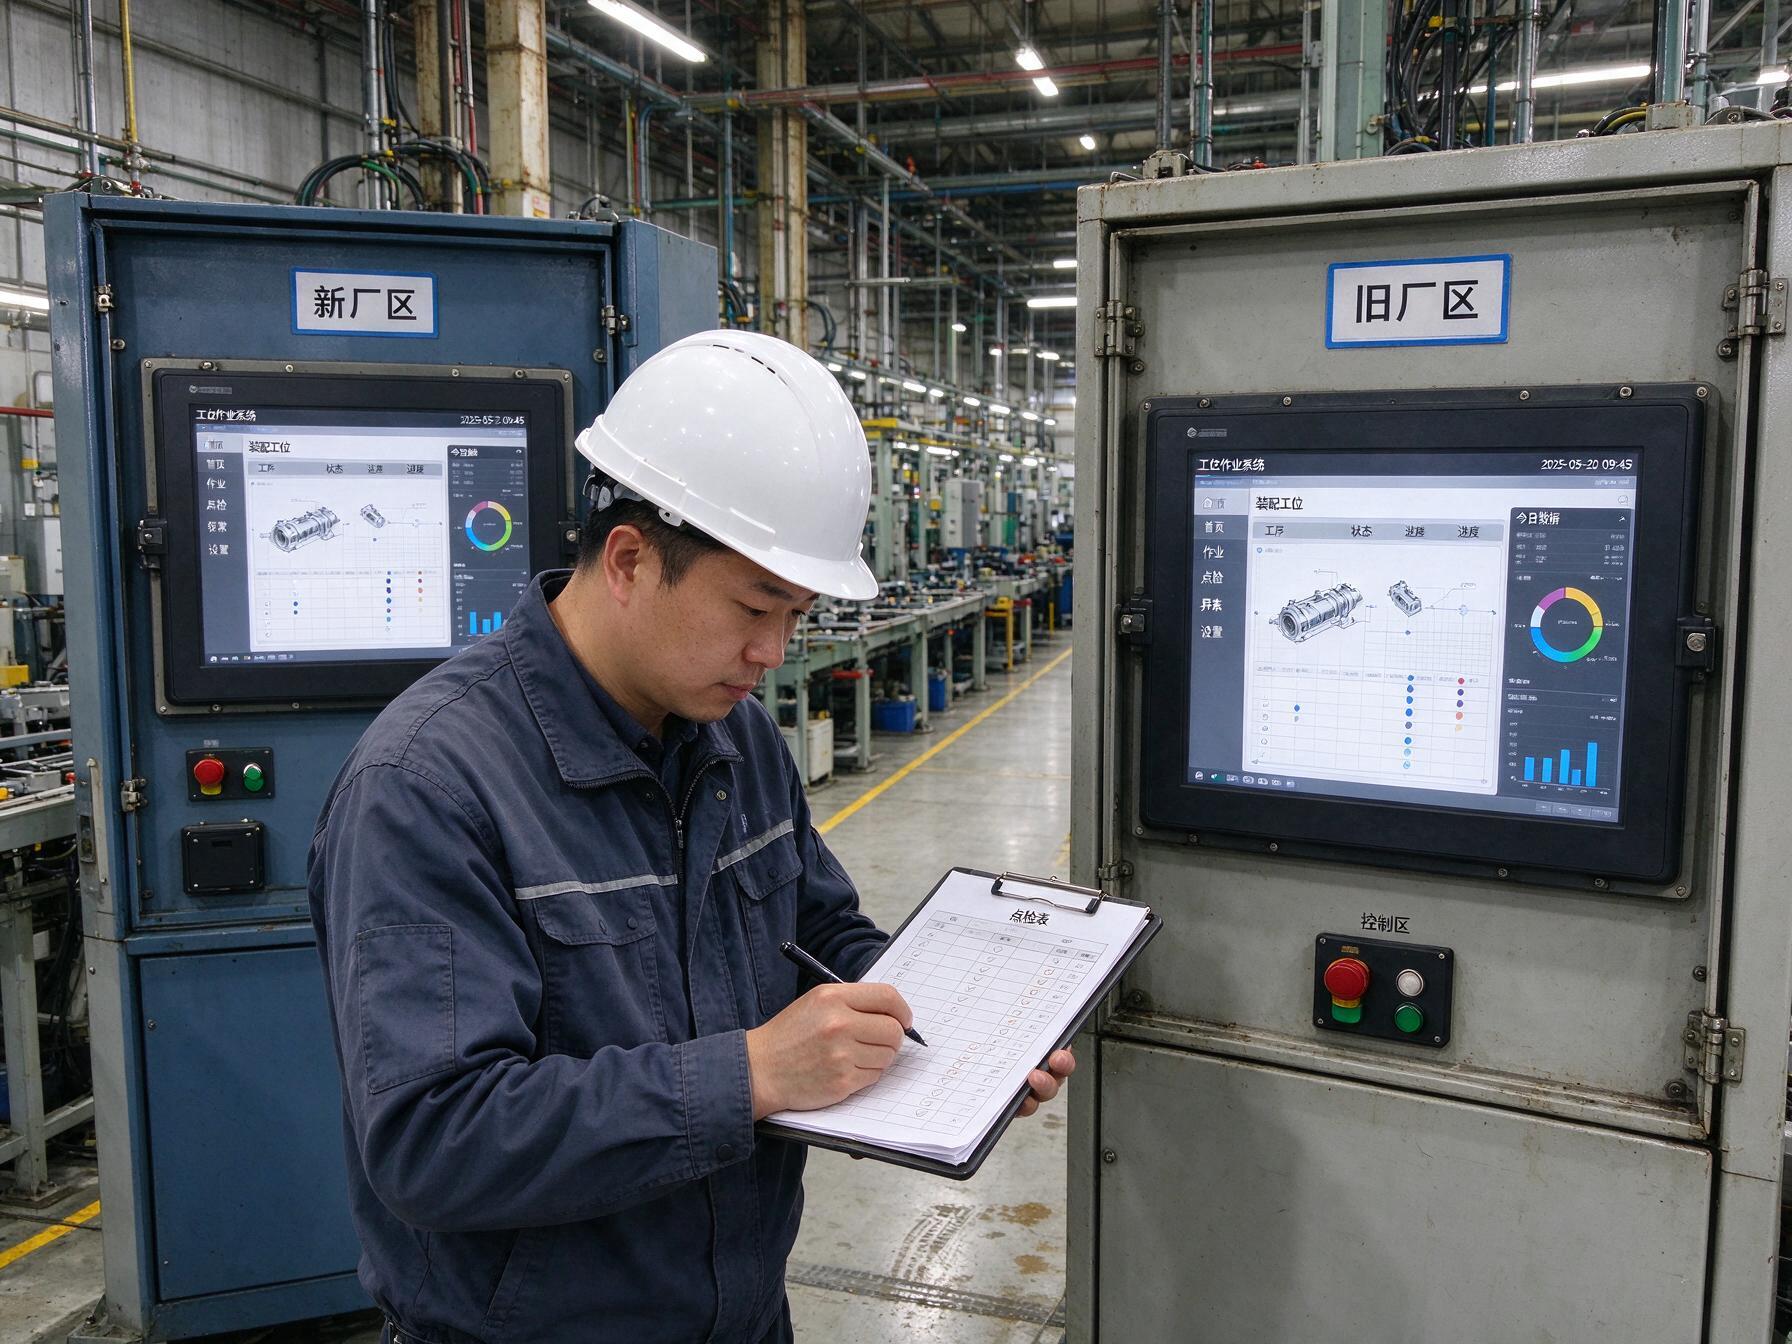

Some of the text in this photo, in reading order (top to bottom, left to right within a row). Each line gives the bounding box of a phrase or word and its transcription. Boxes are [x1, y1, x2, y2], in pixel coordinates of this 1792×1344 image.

[314, 285, 417, 320] 新厂区
[1356, 280, 1478, 323] 旧厂区
[1541, 459, 1633, 471] 2025-05-20 09:45
[1256, 497, 1304, 511] 装配工位
[1205, 520, 1225, 533] 首页
[1351, 525, 1373, 538] 状态
[1203, 545, 1224, 559] 作业
[1361, 912, 1411, 934] 控制区
